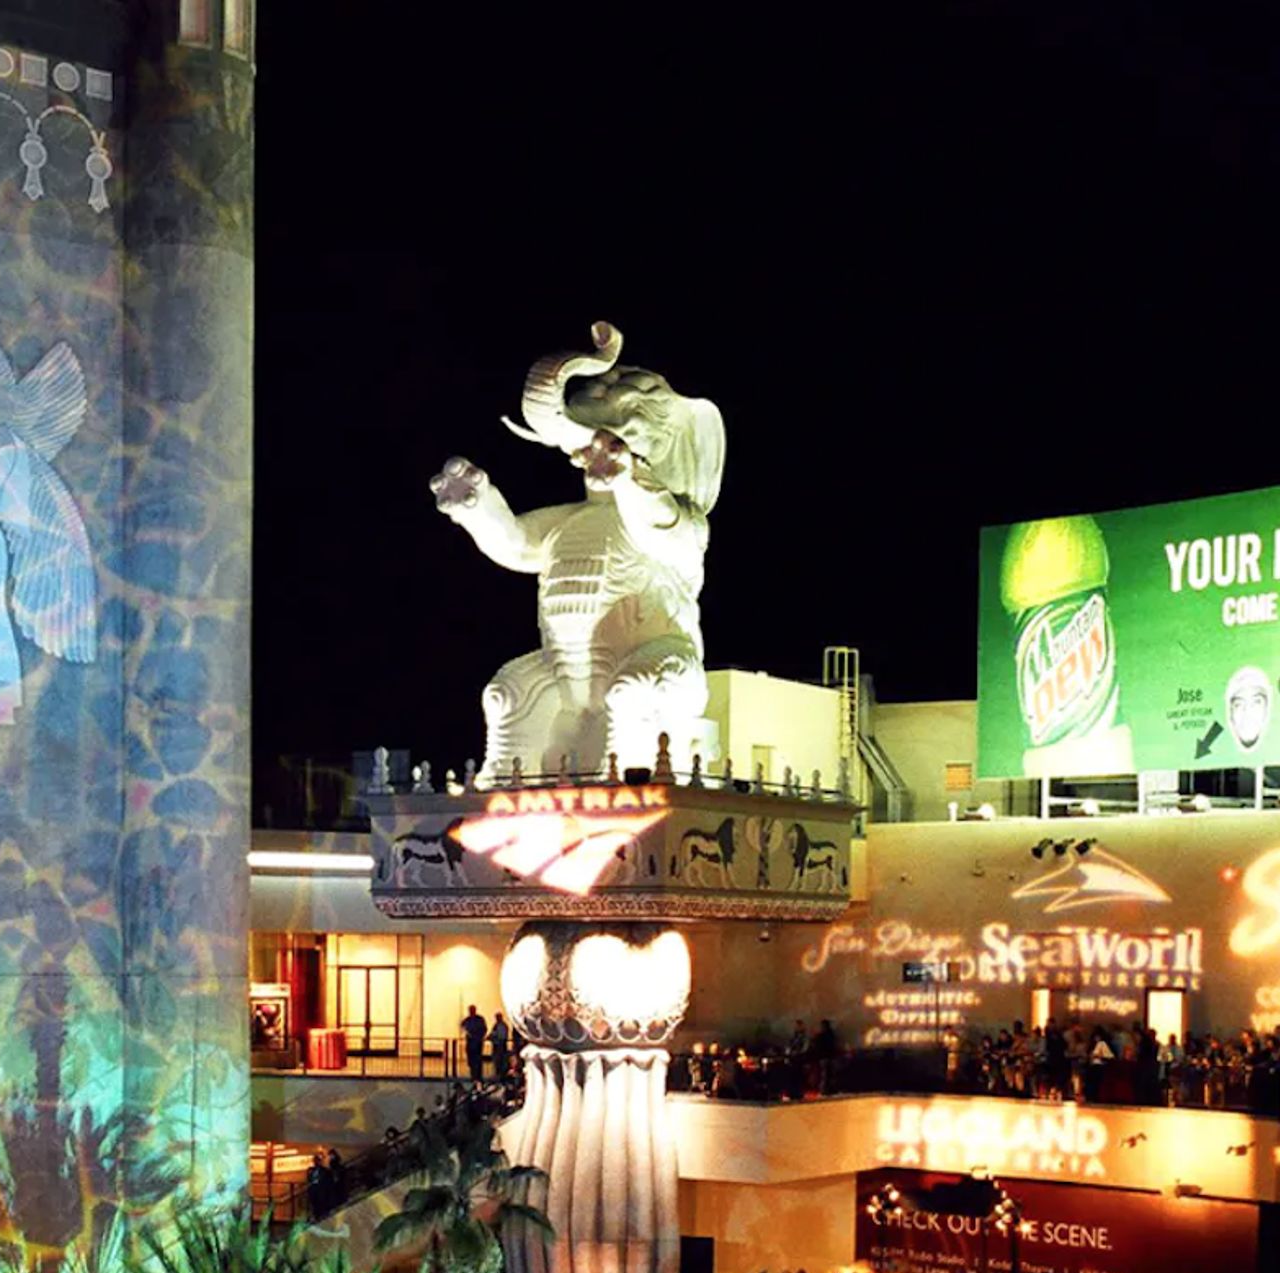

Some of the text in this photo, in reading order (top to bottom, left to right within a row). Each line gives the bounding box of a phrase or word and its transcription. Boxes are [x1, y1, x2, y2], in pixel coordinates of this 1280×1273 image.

[1165, 532, 1262, 592] YOUR
[1222, 592, 1277, 626] COME
[1176, 687, 1203, 704] Jose
[486, 788, 666, 813] AMTRAK
[1098, 994, 1138, 1017] Diego
[1043, 1221, 1112, 1251] SCENE.
